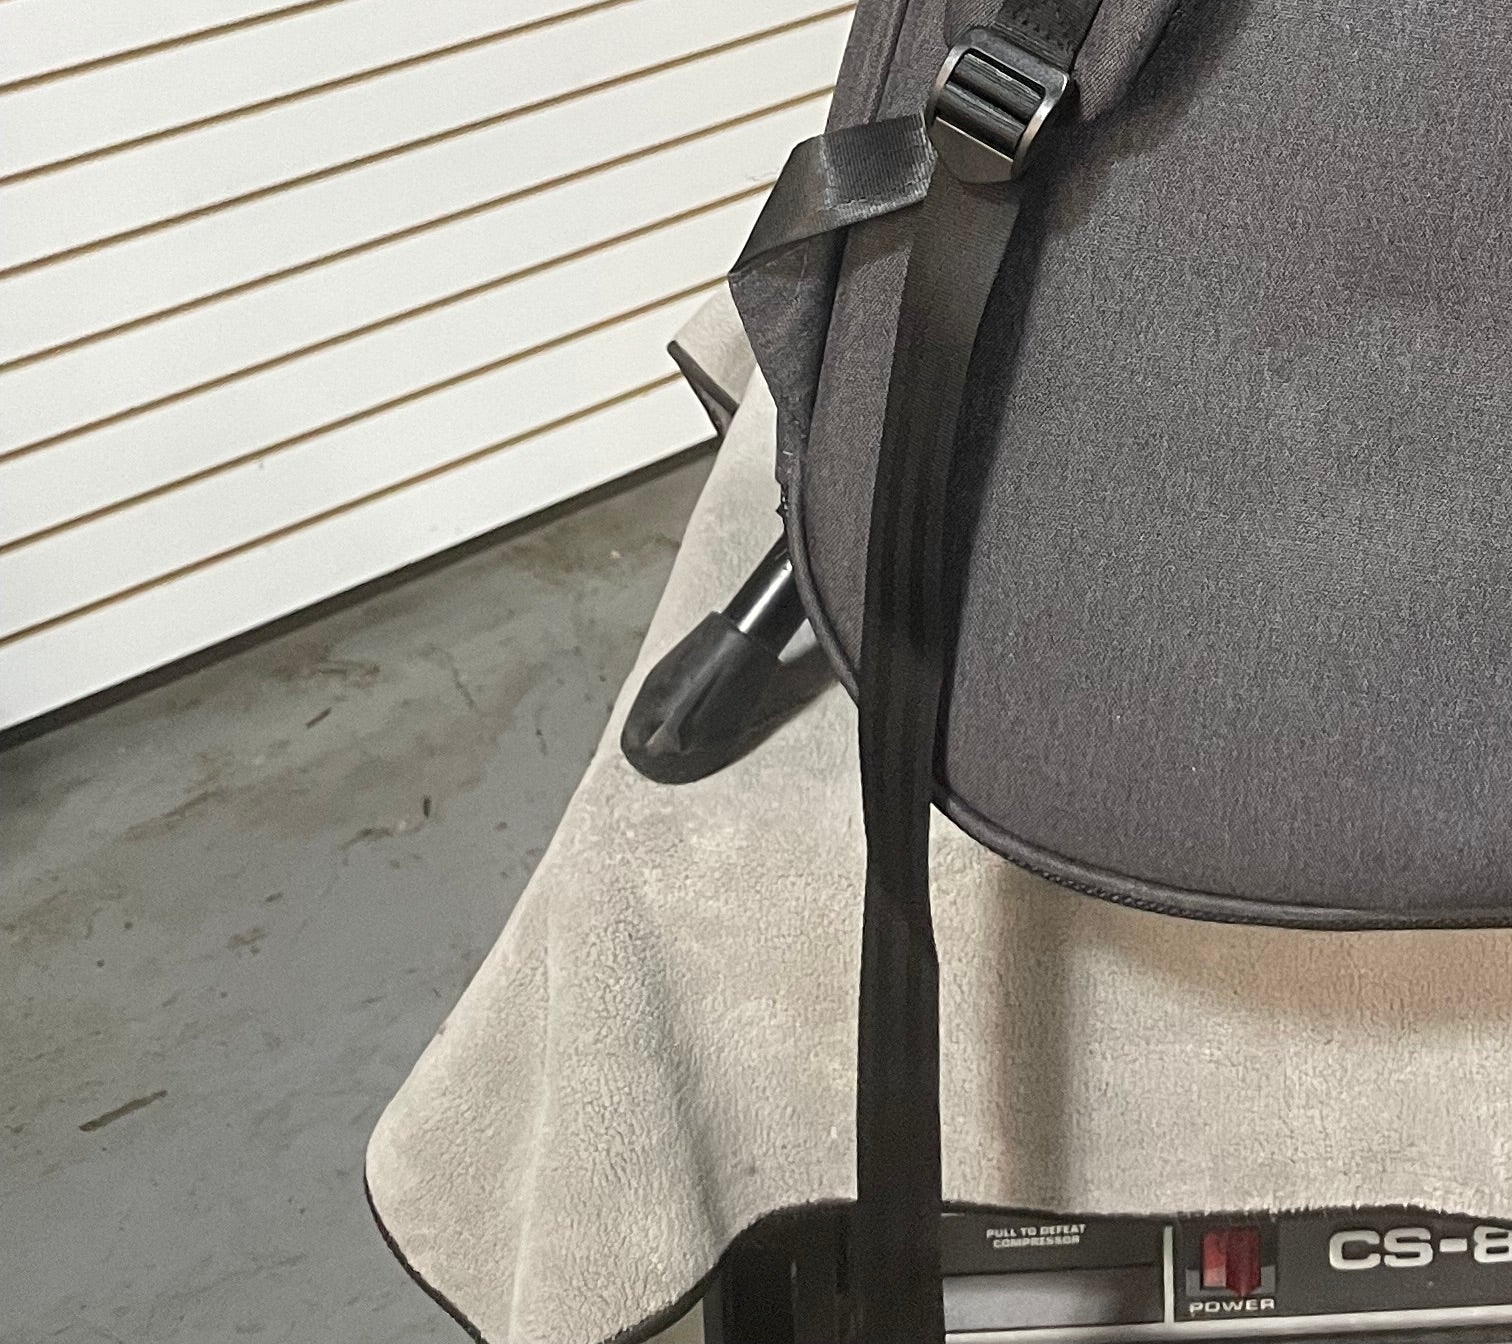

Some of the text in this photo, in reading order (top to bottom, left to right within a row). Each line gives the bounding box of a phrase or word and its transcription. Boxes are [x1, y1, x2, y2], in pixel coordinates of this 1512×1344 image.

[986, 1223, 1086, 1238] PULL TO DEFEAT
[993, 1235, 1080, 1248] COMPRESSOR
[1189, 1298, 1276, 1315] POWER
